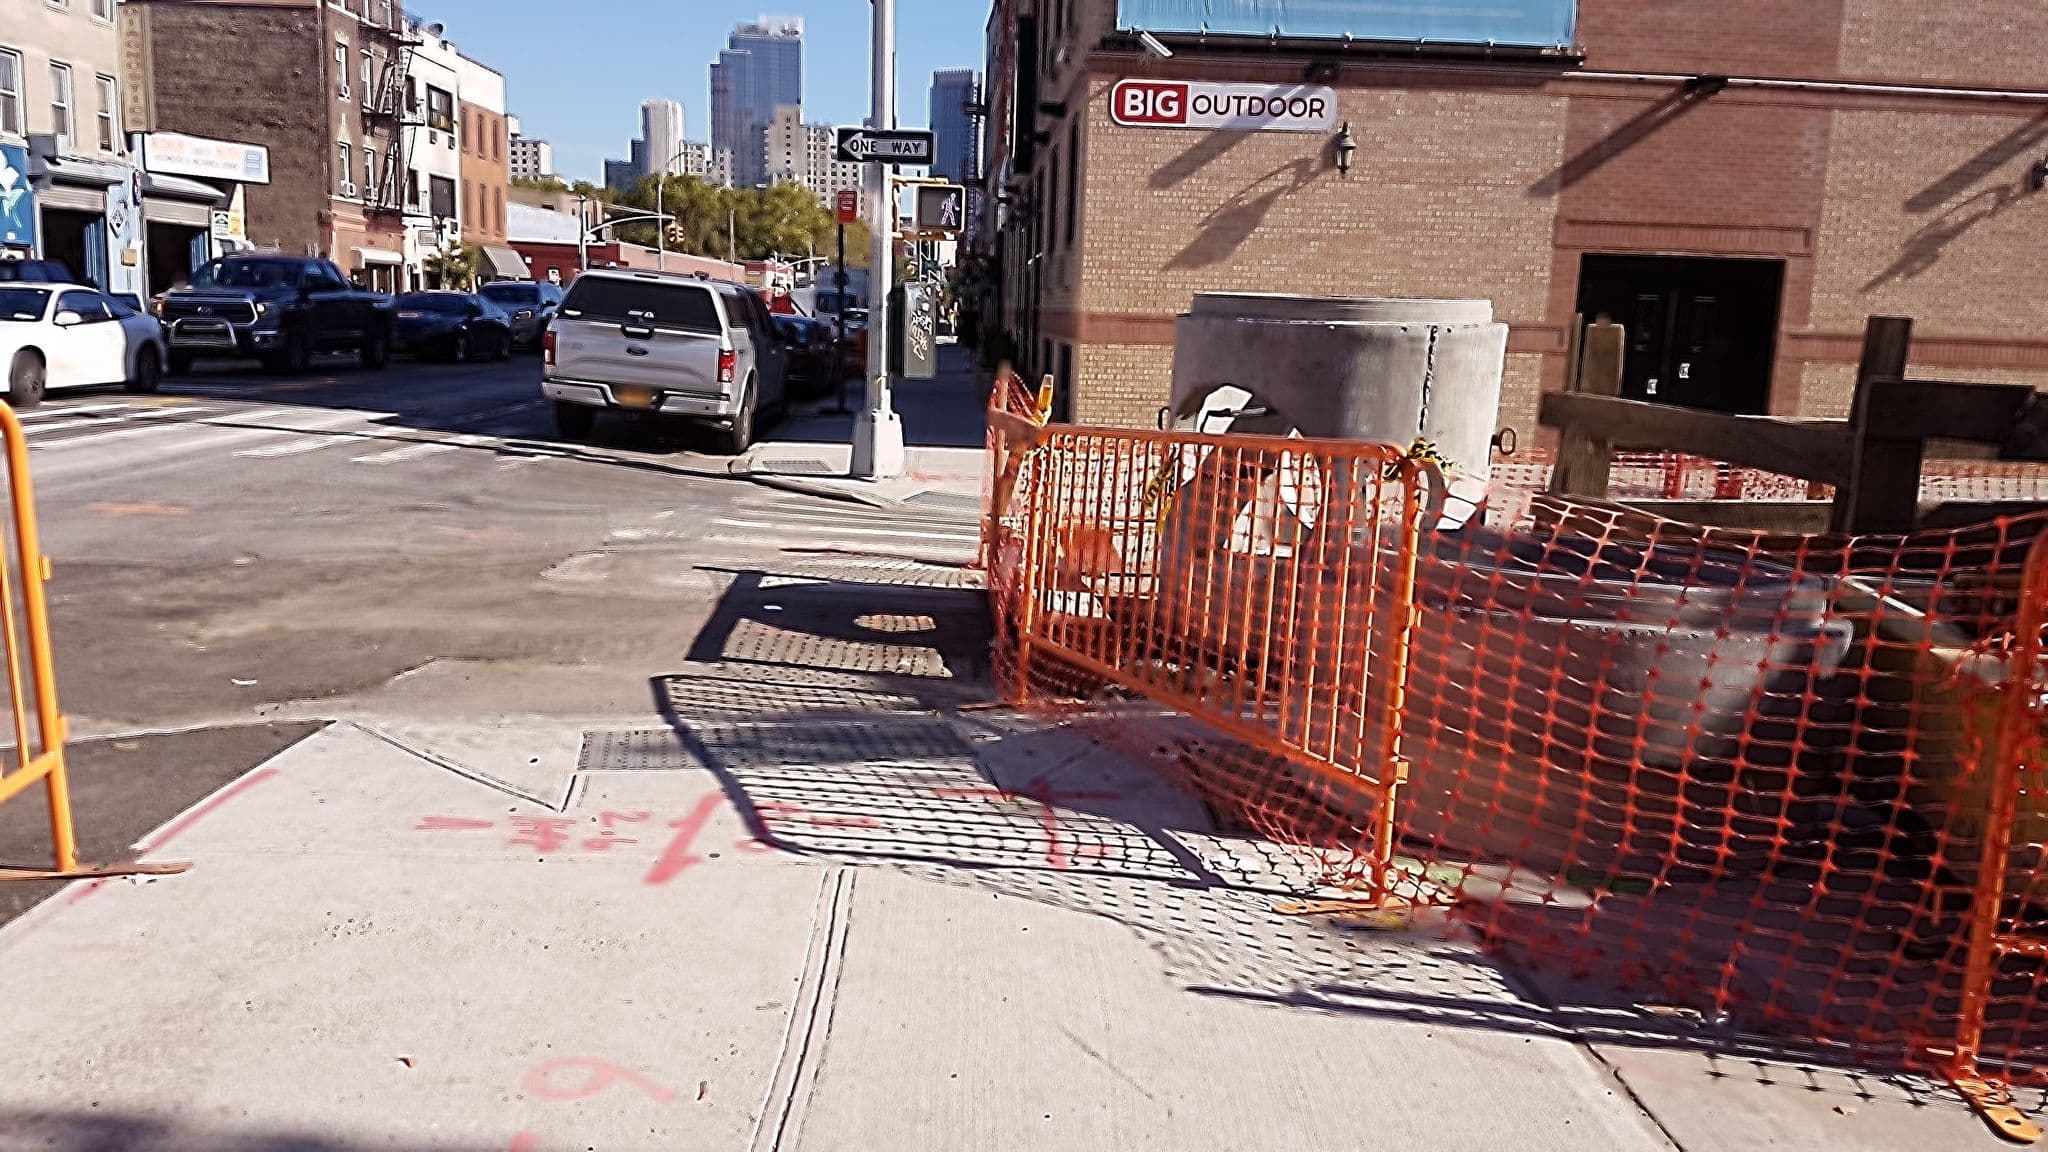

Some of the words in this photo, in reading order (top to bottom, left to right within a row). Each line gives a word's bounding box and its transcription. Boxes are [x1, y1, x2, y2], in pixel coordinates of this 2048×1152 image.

[1124, 88, 1179, 118] BIG
[1192, 95, 1325, 119] OUTDOOR
[850, 139, 878, 153] ONE
[892, 141, 921, 154] WAY
